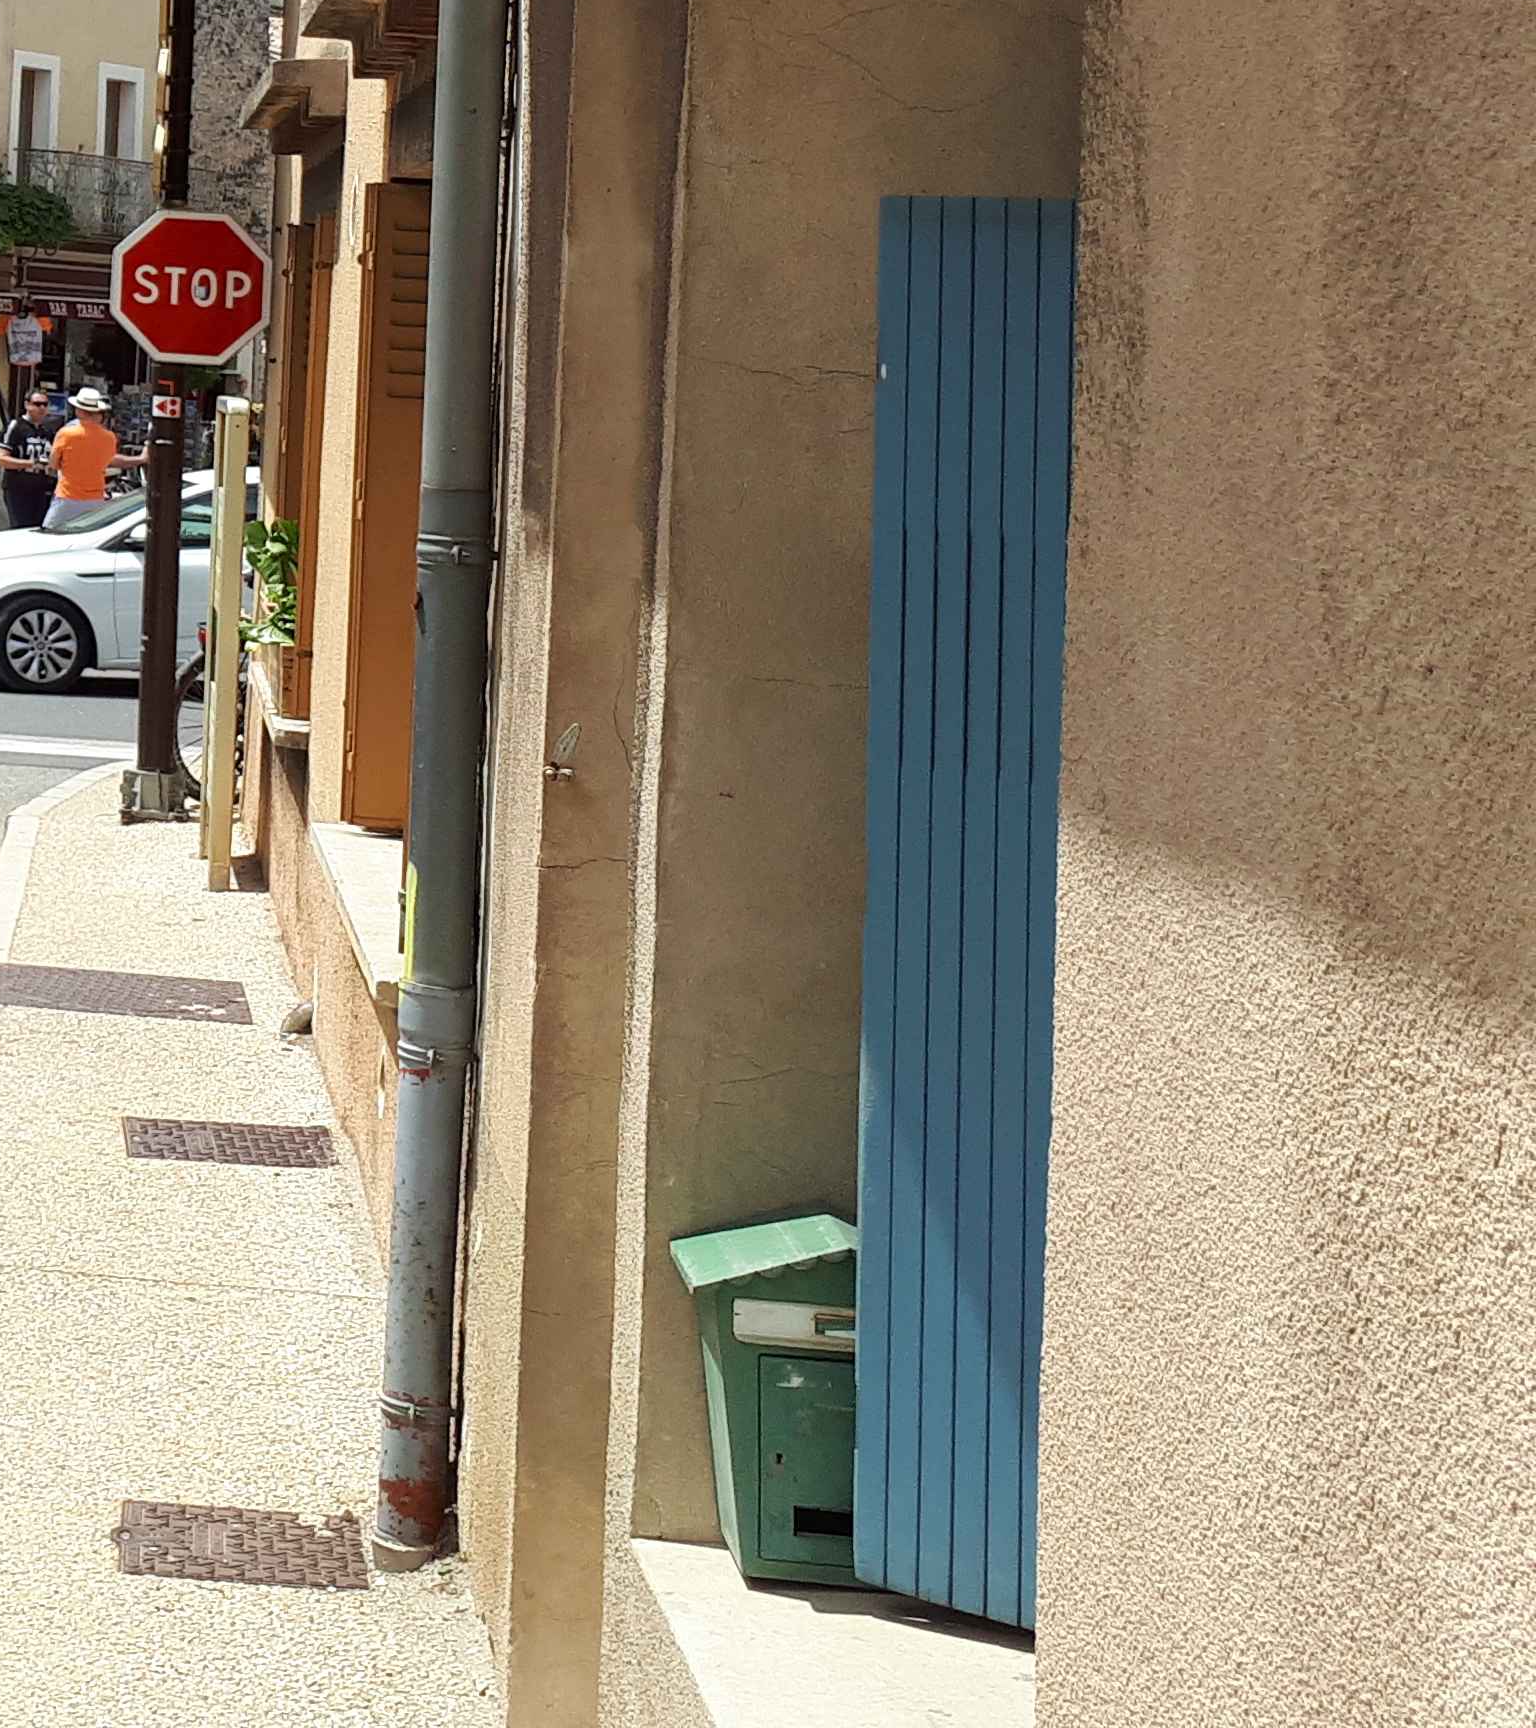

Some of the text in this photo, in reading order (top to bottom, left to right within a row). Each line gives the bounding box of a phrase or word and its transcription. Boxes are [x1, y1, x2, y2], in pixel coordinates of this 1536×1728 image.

[132, 264, 253, 311] STOP
[48, 301, 107, 319] BAR TABAC
